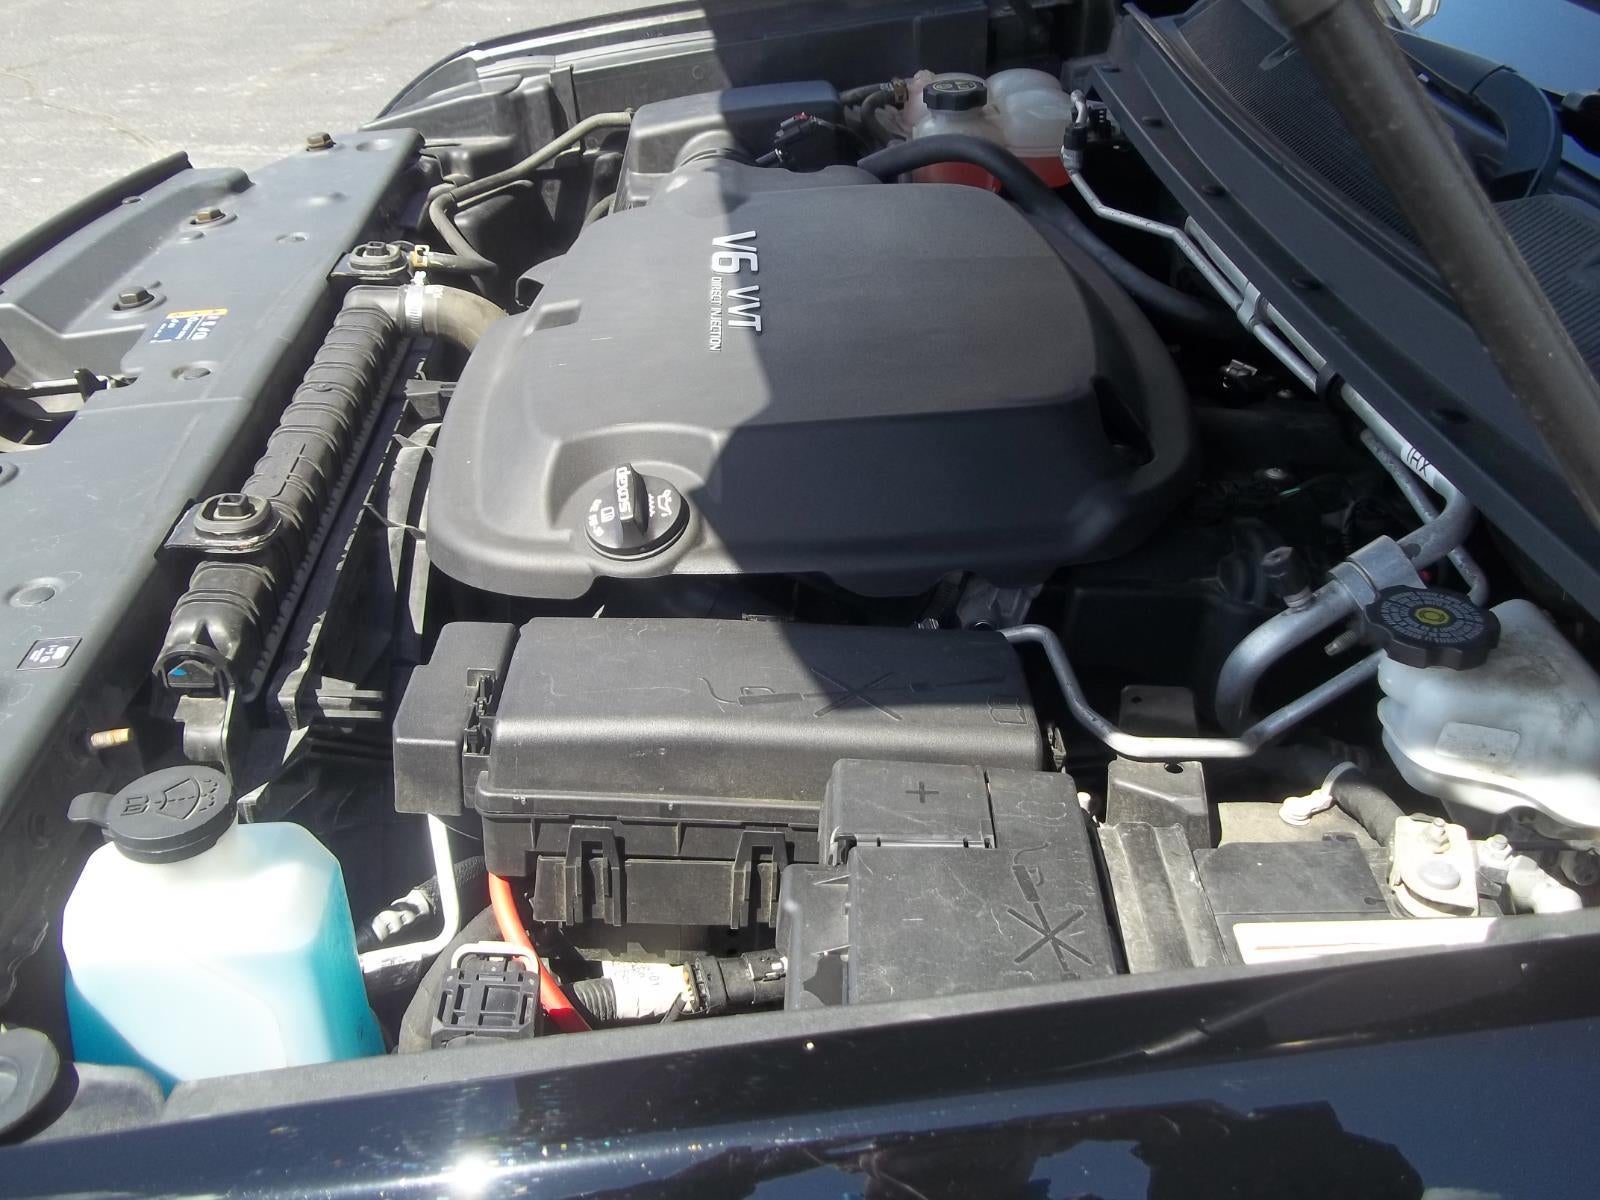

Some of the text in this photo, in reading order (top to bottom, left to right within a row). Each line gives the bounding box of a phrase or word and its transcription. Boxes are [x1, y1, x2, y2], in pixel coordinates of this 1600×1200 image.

[709, 276, 722, 352] DIRECT INJECTION
[711, 230, 762, 332] V6 VVT
